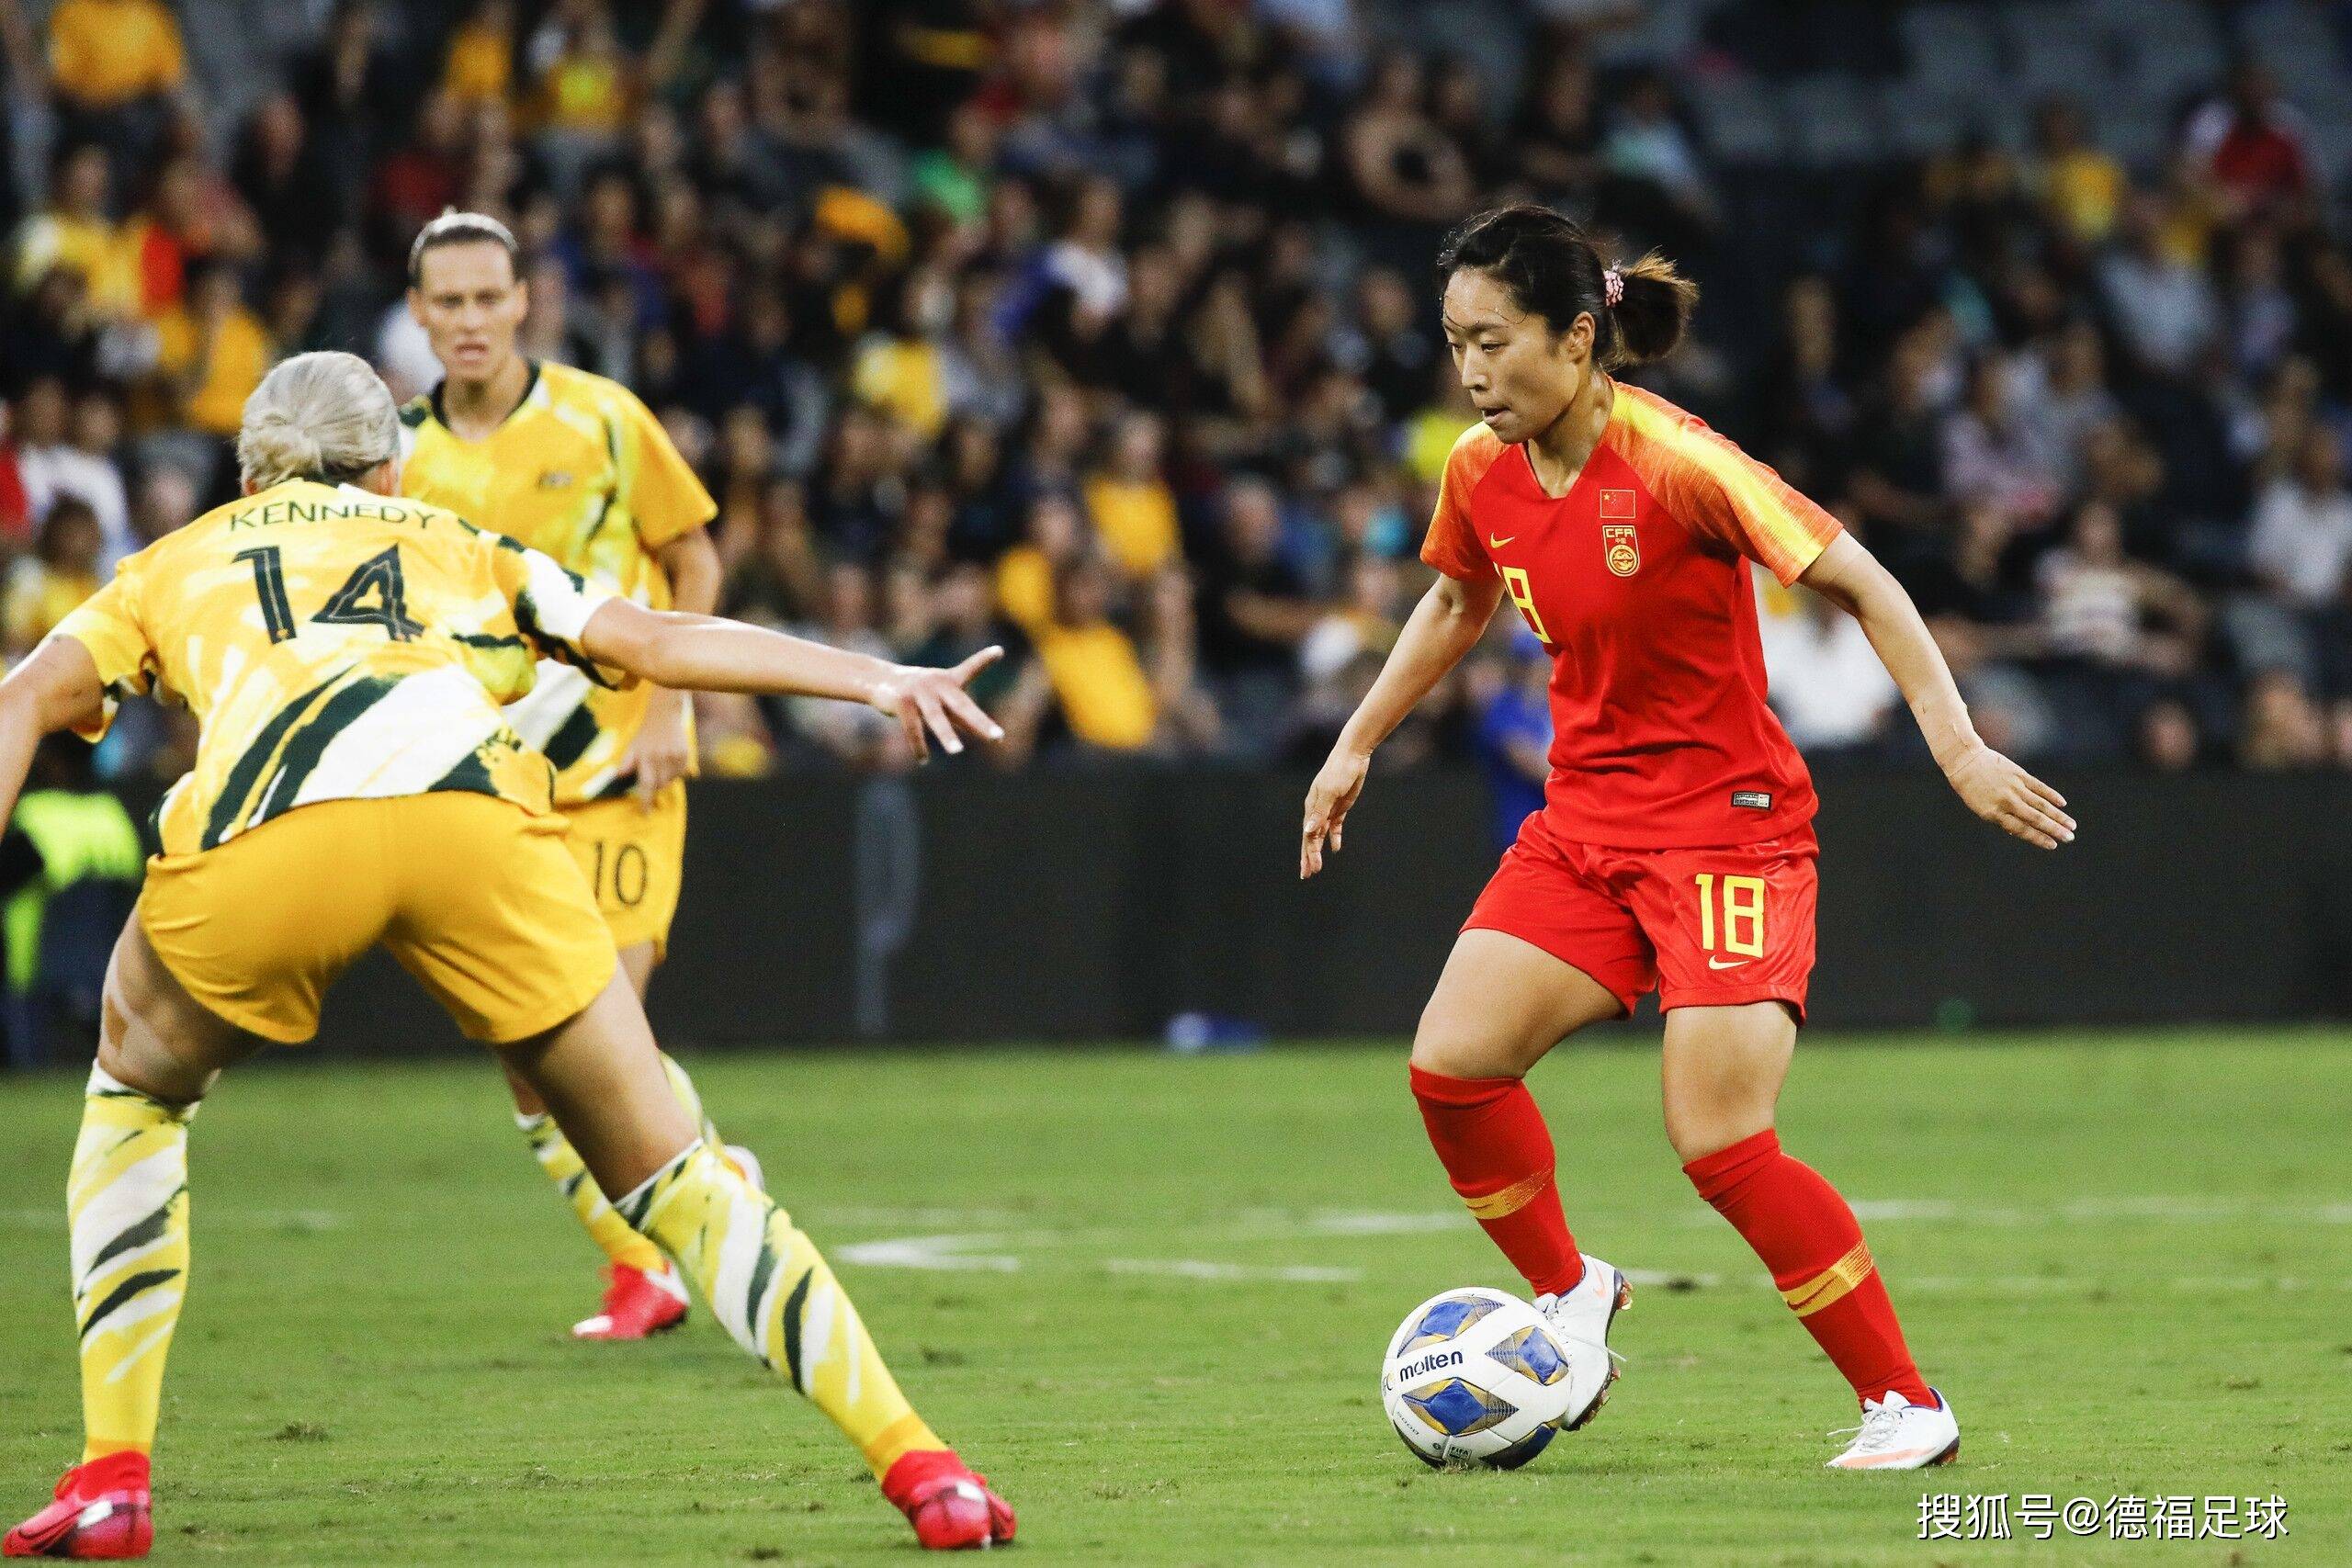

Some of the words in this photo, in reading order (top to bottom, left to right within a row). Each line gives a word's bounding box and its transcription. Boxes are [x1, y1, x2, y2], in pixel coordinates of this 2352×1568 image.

[231, 501, 435, 531] KENNEDY
[1605, 528, 1634, 538] CFA
[231, 542, 425, 645] 14
[594, 840, 647, 907] 10
[1695, 873, 1765, 959] 18
[1399, 1349, 1464, 1382] molten
